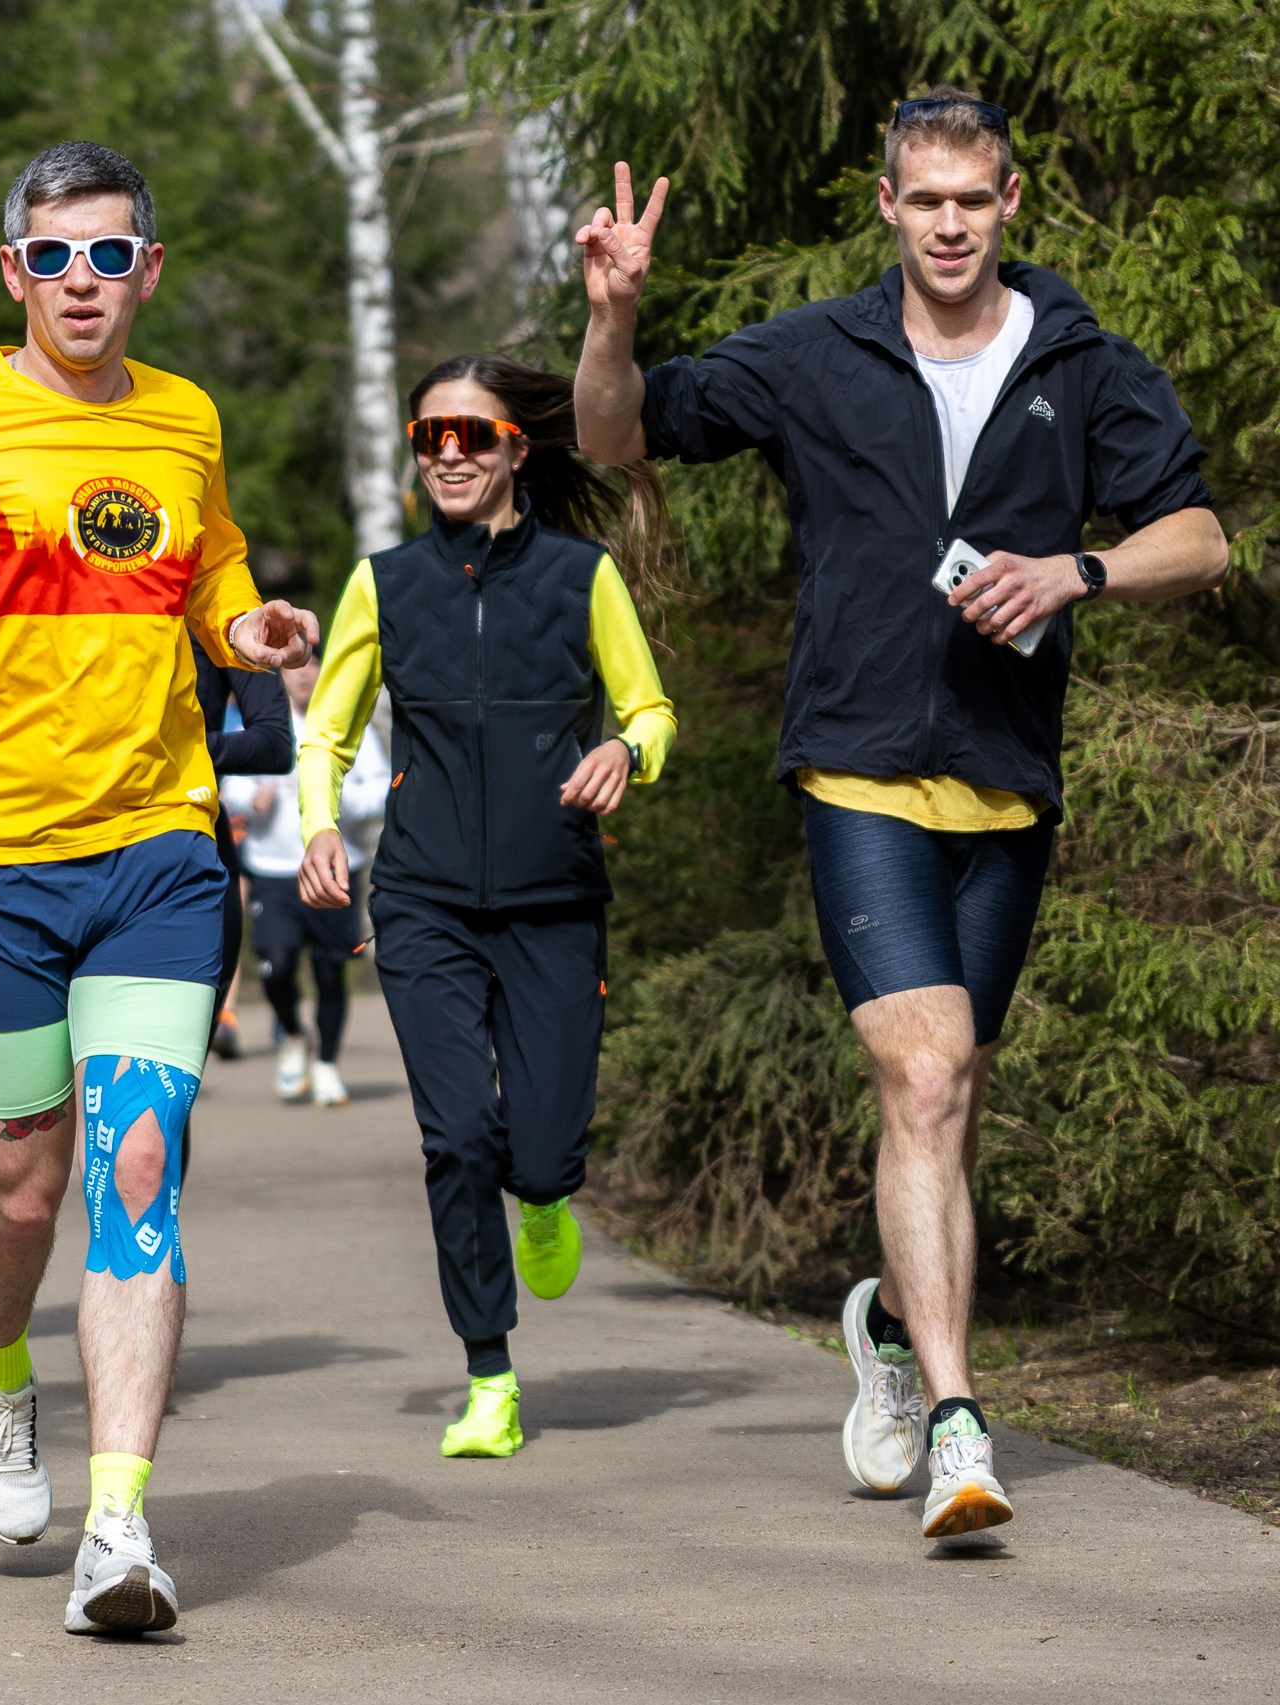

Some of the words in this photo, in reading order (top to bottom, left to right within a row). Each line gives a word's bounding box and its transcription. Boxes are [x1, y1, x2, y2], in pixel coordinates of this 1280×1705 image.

[75, 479, 111, 505] SPARTAK
[112, 479, 158, 509] MOSCOW
[86, 529, 112, 555] SQUAD
[88, 553, 149, 573] SUPPORTERS
[86, 1157, 100, 1199] clinic
[93, 1160, 110, 1239] millenium
